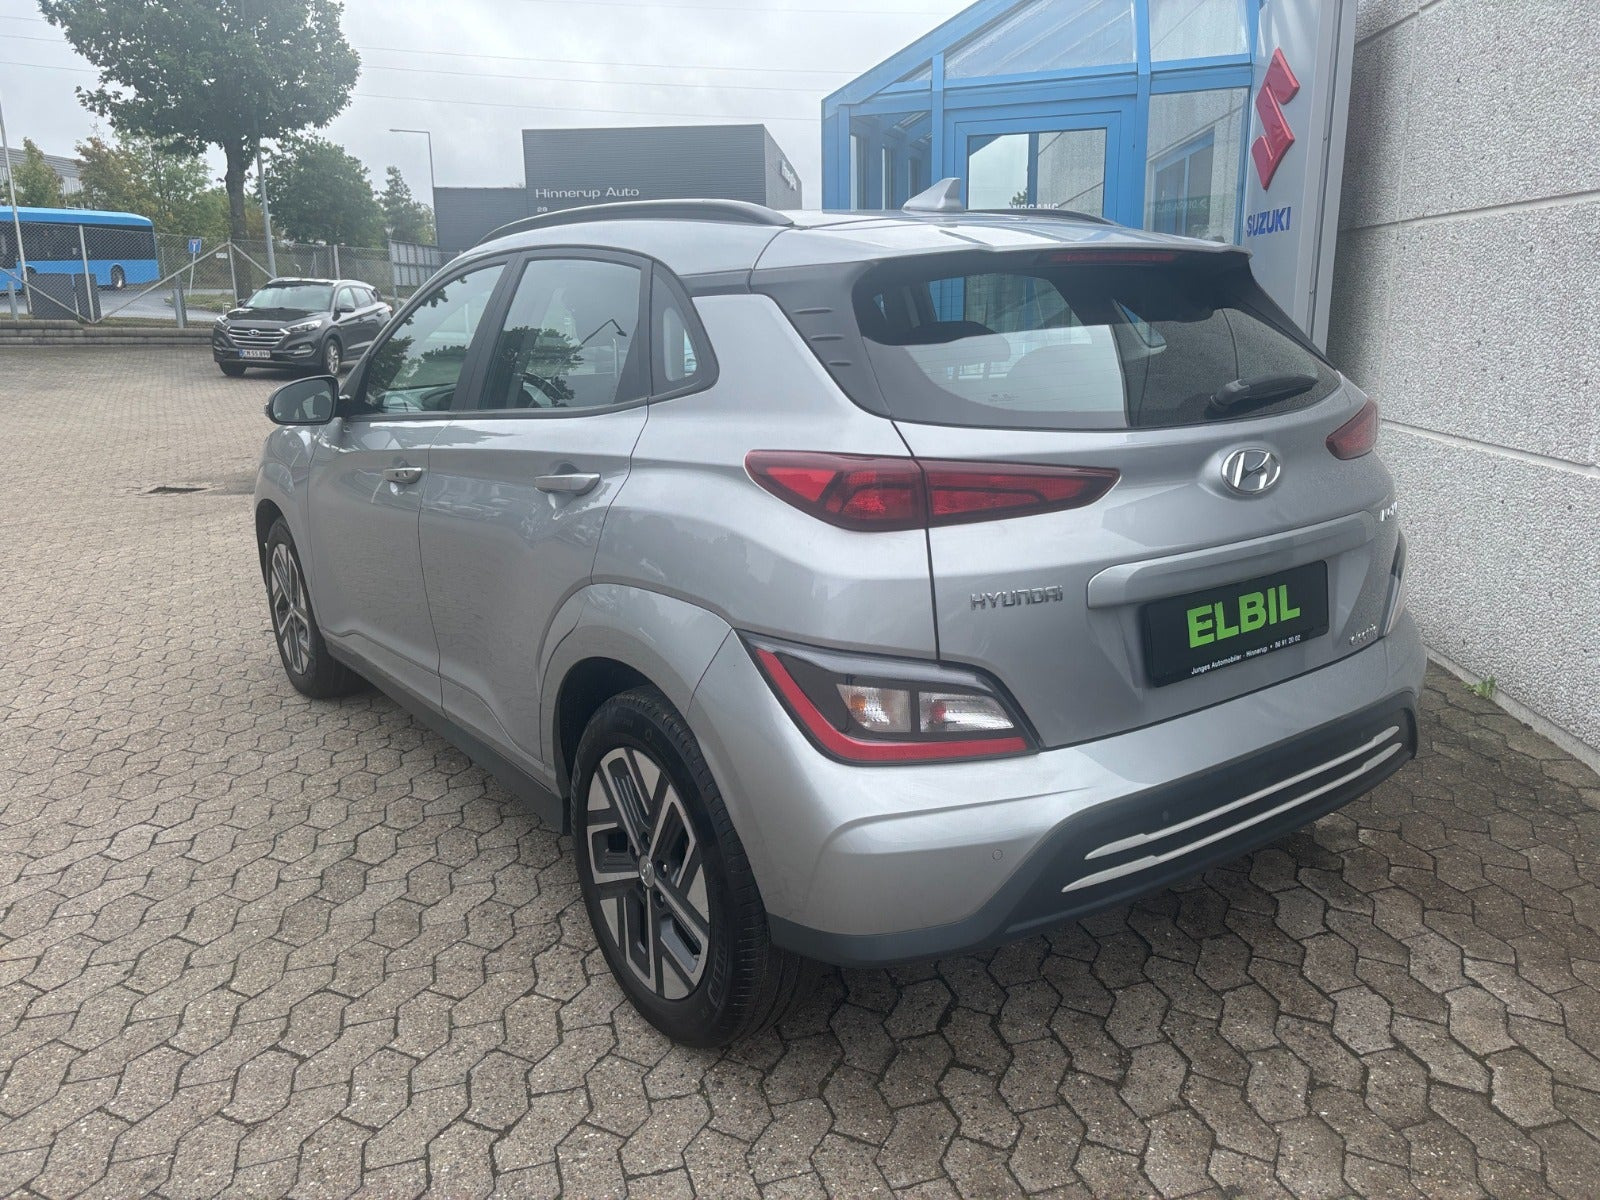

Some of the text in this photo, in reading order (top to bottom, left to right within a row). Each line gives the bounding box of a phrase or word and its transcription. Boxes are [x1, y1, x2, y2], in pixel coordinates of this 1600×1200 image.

[535, 187, 640, 199] Hinnerup Auto
[1246, 206, 1292, 238] SUZUKI
[970, 584, 1064, 611] HYUNDAI
[1186, 584, 1301, 649] ELBIL
[1191, 664, 1210, 675] Junges
[1246, 646, 1268, 657] Hinnerup
